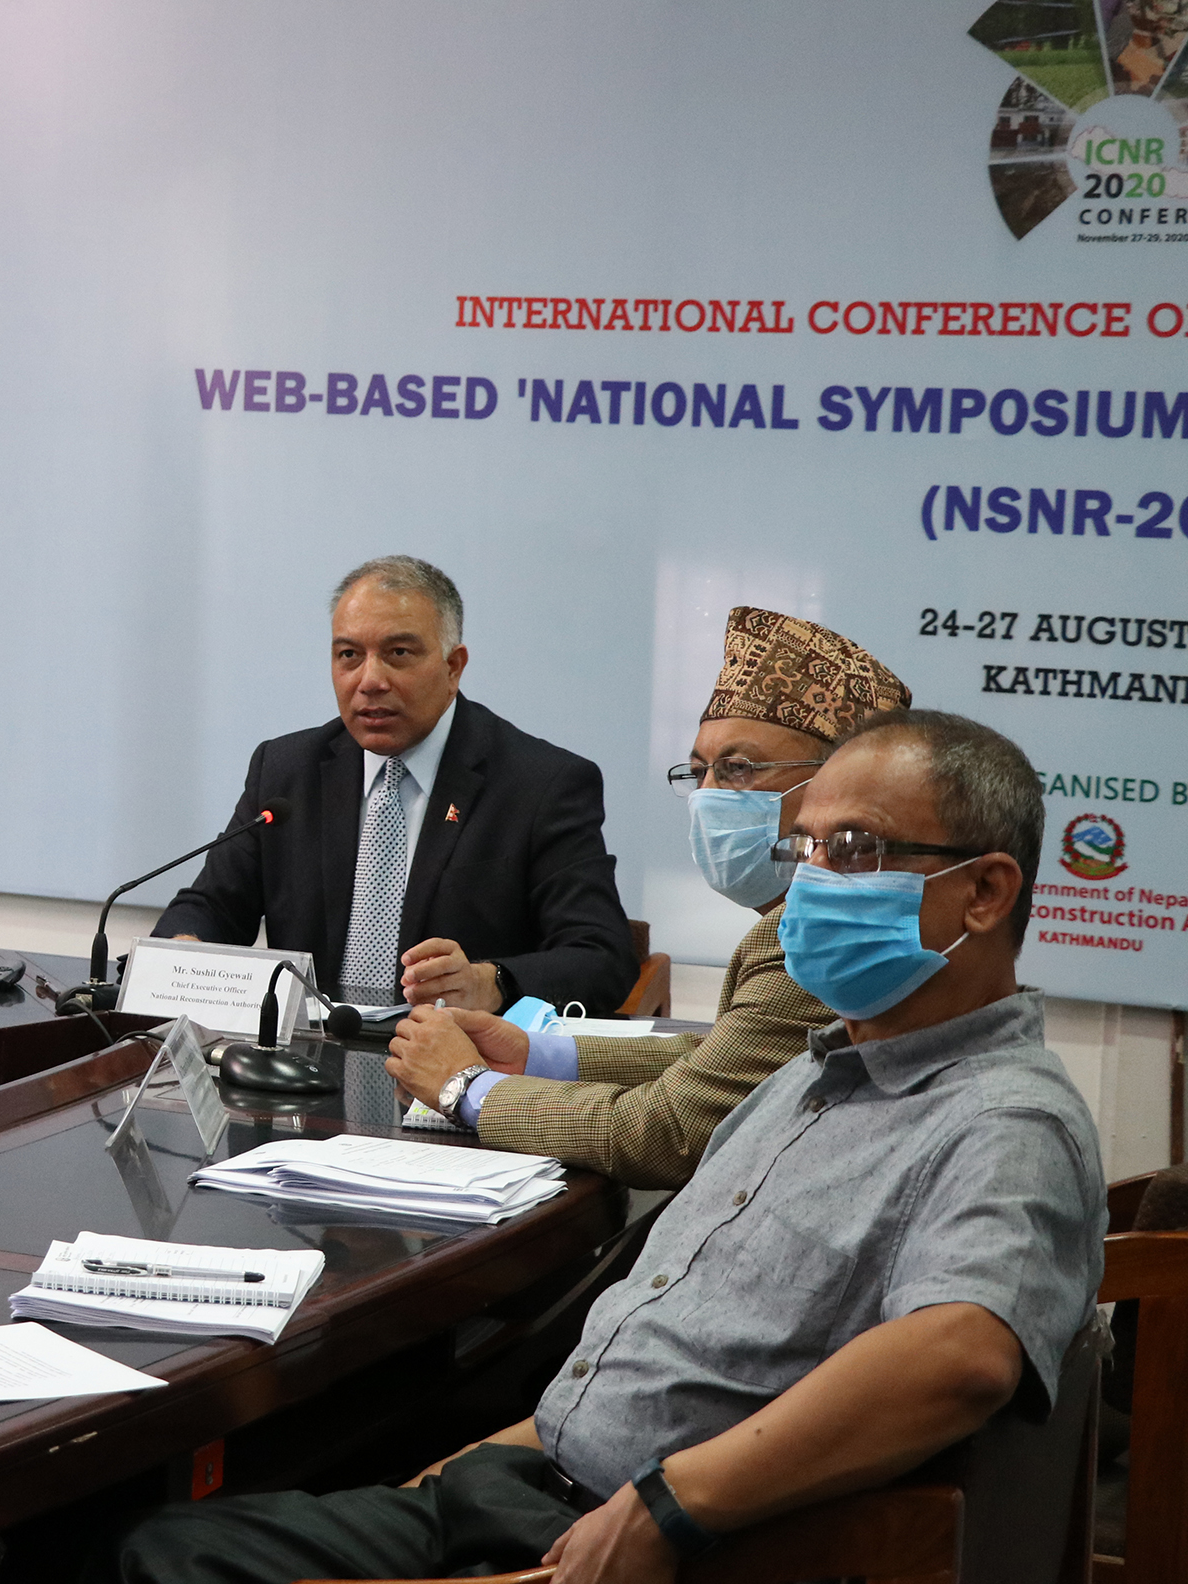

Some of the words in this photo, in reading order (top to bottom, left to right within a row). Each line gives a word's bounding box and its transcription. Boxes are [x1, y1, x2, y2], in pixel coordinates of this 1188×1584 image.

[1085, 138, 1165, 166] ICNR
[1083, 172, 1166, 199] 2020
[1077, 233, 1128, 242] November
[1131, 233, 1162, 243] 27-29,
[455, 296, 794, 334] INTERNATIONAL
[807, 301, 1131, 338] CONFERENCE
[1147, 302, 1188, 338] O
[194, 368, 499, 420] WEB-BASED
[518, 378, 800, 430] 'NATIONAL
[817, 385, 1188, 439] SYMPOSIUM
[921, 485, 1188, 541] (NSNR-2
[919, 608, 1019, 640] 24-27
[1029, 614, 1188, 650] AUGUST
[981, 665, 1188, 705] KATHMAN
[1114, 887, 1136, 903] of
[1038, 930, 1144, 951] KATHMANDU
[172, 966, 188, 975] Mr.
[190, 967, 216, 978] Sushil
[218, 970, 253, 981] Gyewali
[151, 992, 178, 1001] National
[179, 995, 229, 1006] Reconstruction
[171, 981, 190, 989] Chief
[191, 983, 222, 993] Executive
[223, 986, 248, 995] Officer
